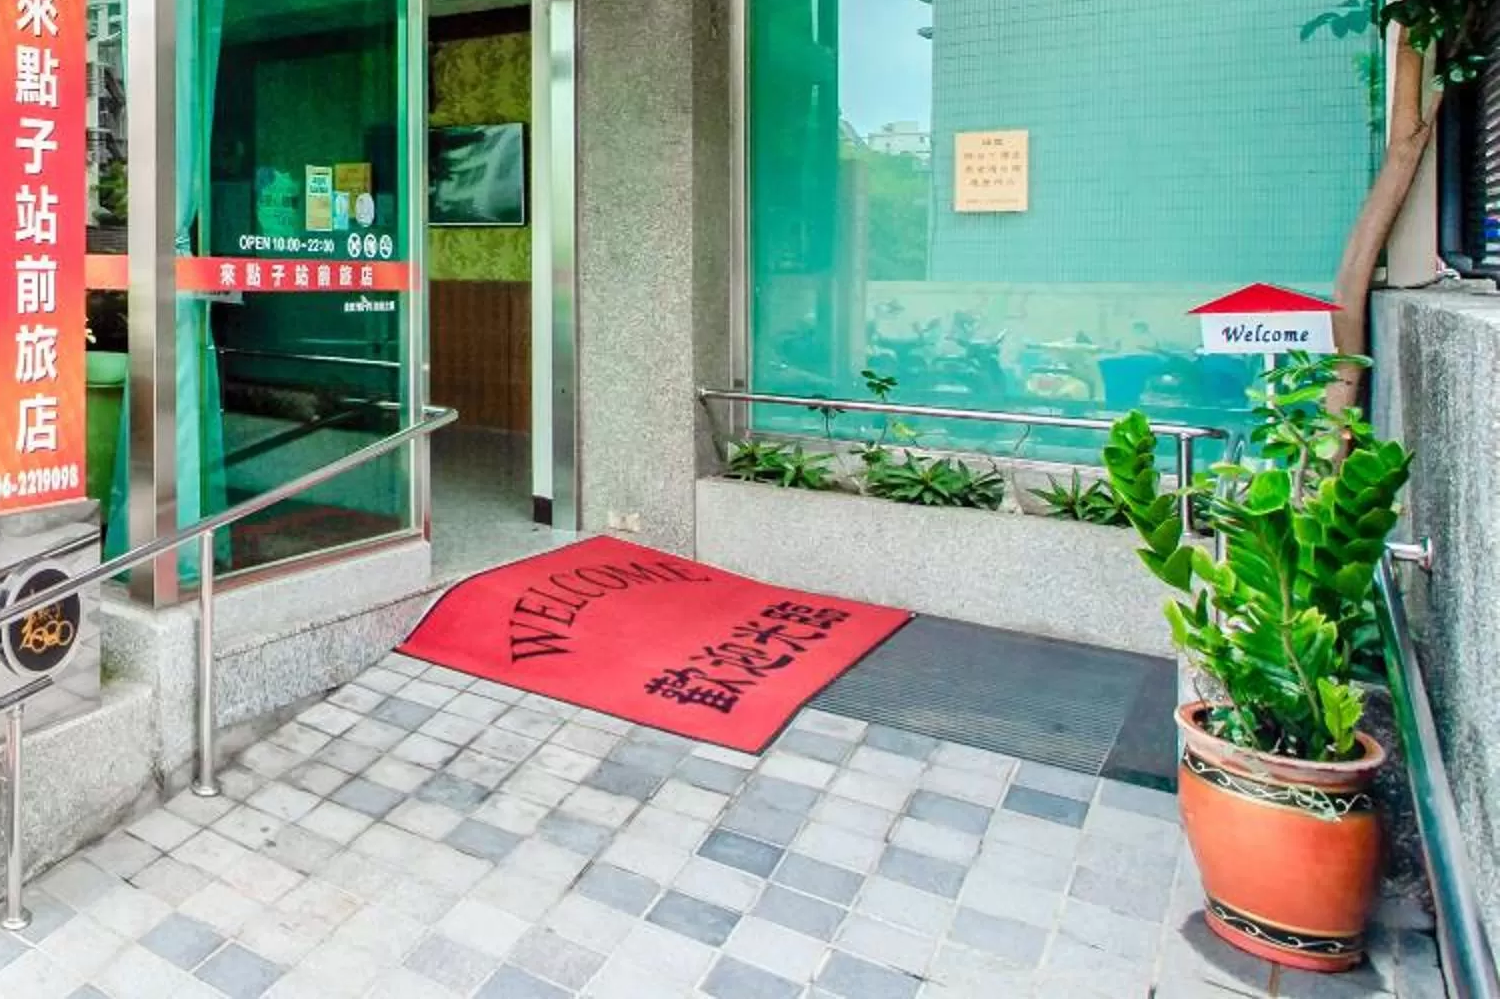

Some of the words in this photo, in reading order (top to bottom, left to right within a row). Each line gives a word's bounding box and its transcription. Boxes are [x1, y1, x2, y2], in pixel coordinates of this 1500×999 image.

[239, 234, 271, 250] OPEN
[219, 263, 373, 287] 來點子站前旅店
[1221, 324, 1309, 343] Welcome
[510, 561, 709, 663] WELCOME
[644, 601, 851, 714] 歡迎光臨
